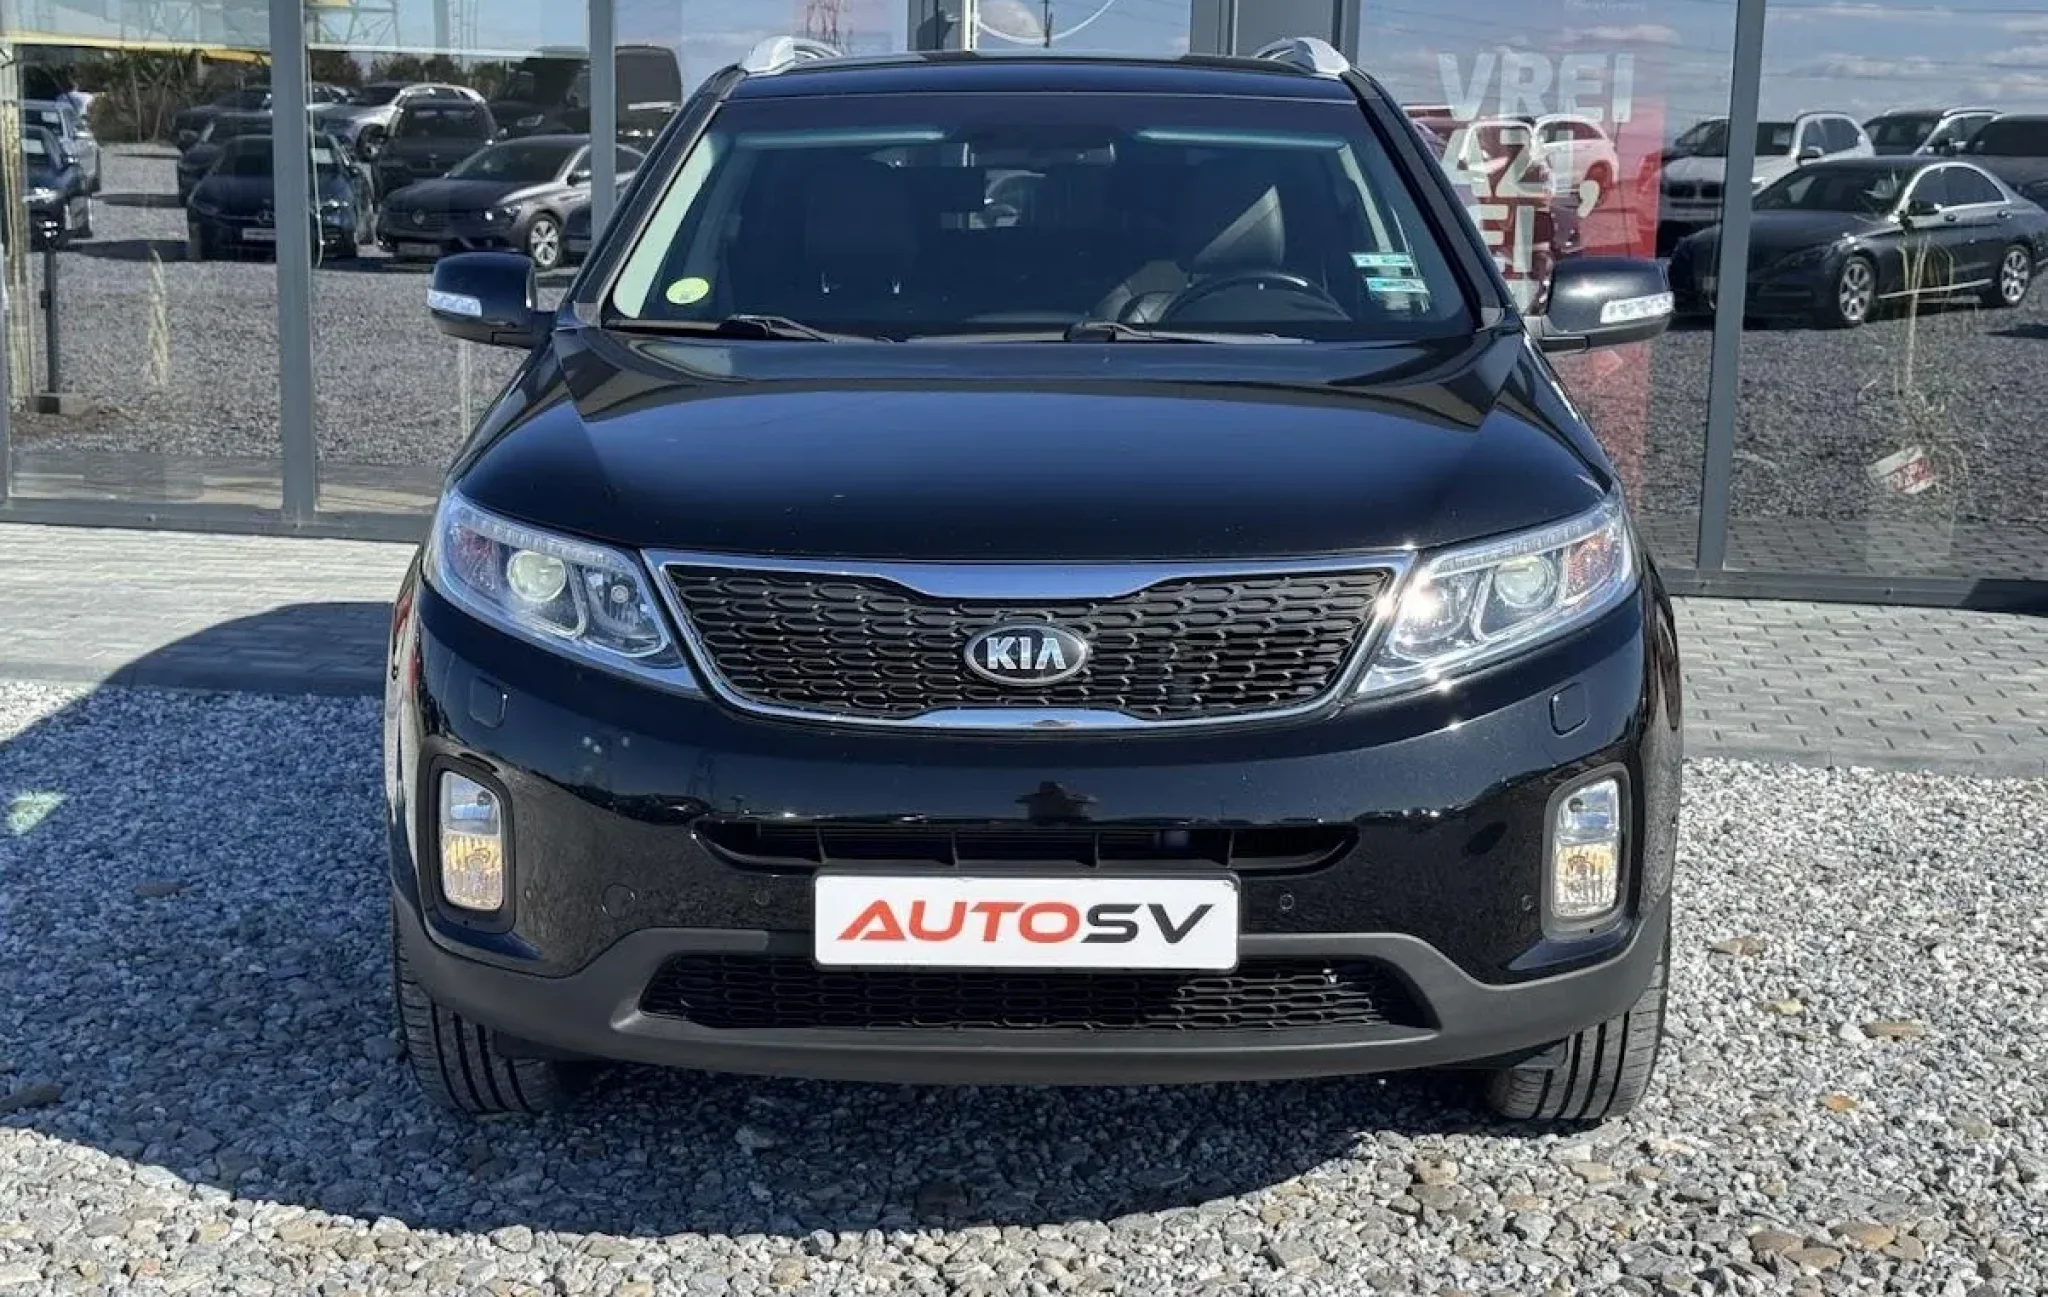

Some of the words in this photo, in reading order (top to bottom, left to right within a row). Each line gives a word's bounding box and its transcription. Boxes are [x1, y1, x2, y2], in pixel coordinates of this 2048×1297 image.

[1438, 52, 1634, 123] VREI
[986, 636, 1067, 670] KIA
[836, 899, 1214, 944] AUTOSV
